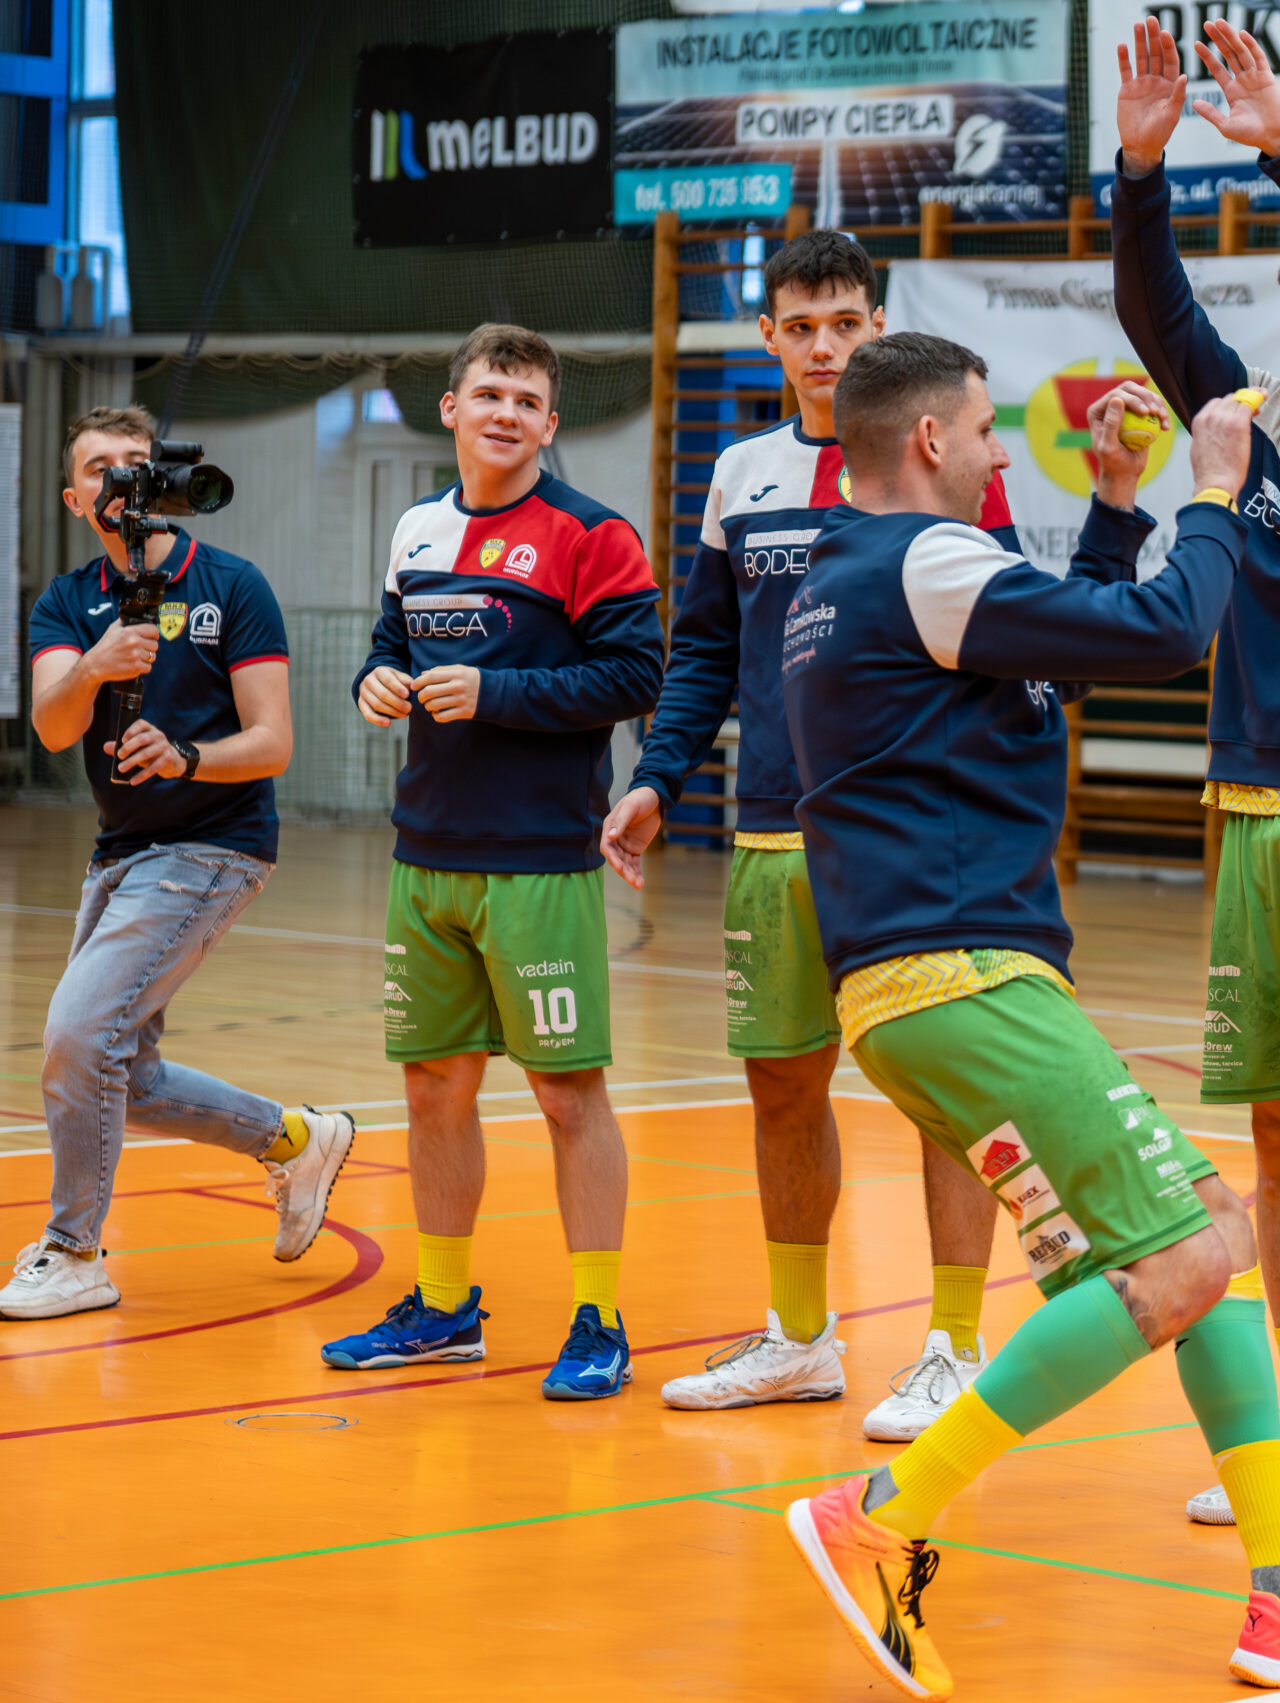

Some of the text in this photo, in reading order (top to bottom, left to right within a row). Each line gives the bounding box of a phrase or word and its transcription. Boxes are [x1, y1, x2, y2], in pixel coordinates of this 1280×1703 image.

[656, 18, 1038, 69] INSTALACJE FOTOWOLTAICZNE
[741, 100, 945, 139] POMPY CIEPŁA
[404, 612, 489, 638] ODEGA
[516, 958, 576, 978] vadain
[528, 986, 577, 1036] 10
[1207, 987, 1242, 1003] SCAL
